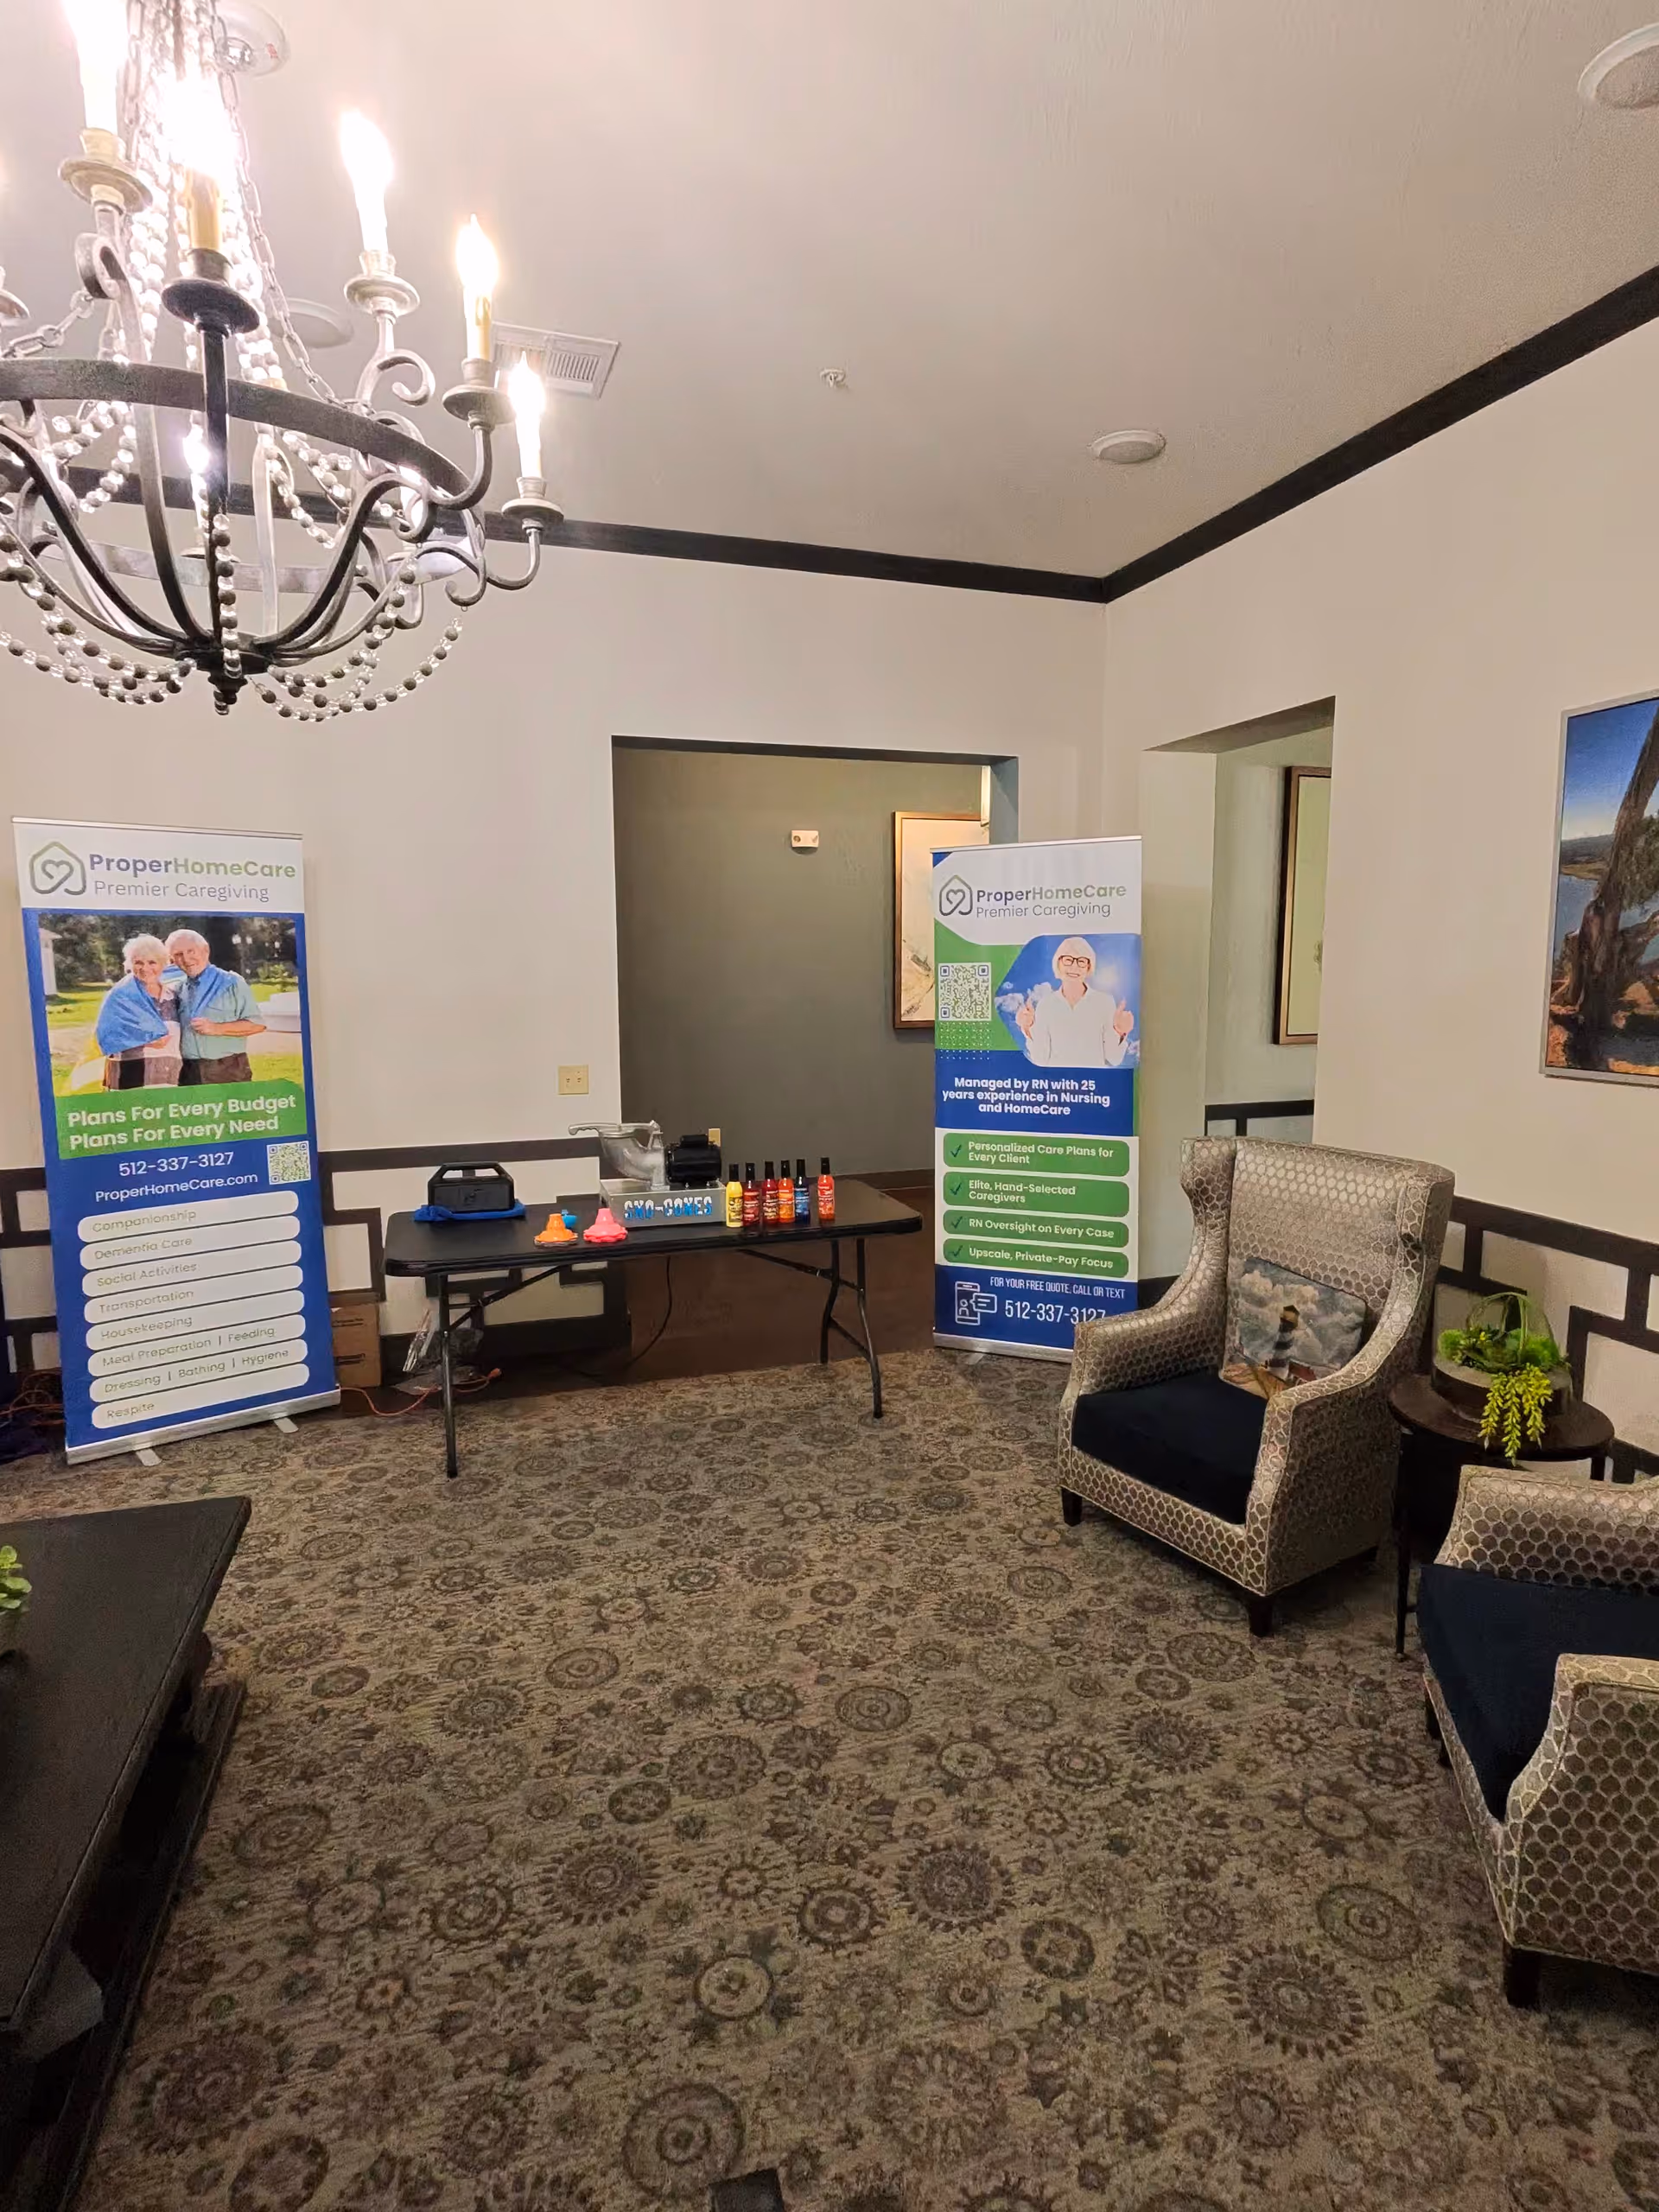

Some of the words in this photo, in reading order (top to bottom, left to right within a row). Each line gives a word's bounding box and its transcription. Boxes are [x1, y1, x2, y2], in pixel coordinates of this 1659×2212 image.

[89, 854, 296, 878] ProperHomeCare
[94, 880, 169, 898] Premier
[175, 882, 270, 902] Caregiving
[976, 884, 1127, 906] ProperHomeCare
[976, 906, 1028, 918] Premier
[1033, 902, 1111, 918] Caregiving
[954, 1077, 1012, 1090] Managed
[1014, 1079, 1029, 1092] by
[1032, 1079, 1049, 1090] RN
[1051, 1079, 1078, 1090] with
[1081, 1080, 1096, 1090] 25
[942, 1090, 975, 1102] years
[976, 1091, 1044, 1103] experience
[1046, 1091, 1058, 1103] in
[1061, 1092, 1110, 1107] Nursing
[978, 1103, 1002, 1113] and
[1004, 1103, 1071, 1116] HomeCare
[67, 1109, 126, 1128] Plans
[131, 1106, 164, 1122] For
[168, 1103, 223, 1118] Every
[227, 1095, 296, 1114] Budget
[69, 1132, 128, 1150] Plans
[133, 1128, 165, 1142] For
[170, 1123, 225, 1140] Every
[229, 1116, 278, 1134] Need
[969, 1141, 1035, 1154] Personalized
[1037, 1145, 1064, 1154] Care
[1066, 1146, 1096, 1156] Plans
[1097, 1147, 1114, 1158] for
[969, 1152, 996, 1164] Every
[999, 1153, 1030, 1164] Client
[119, 1152, 234, 1176] 512-337-3127
[95, 1174, 258, 1202] ProperHomeCare.com
[969, 1179, 993, 1192] Elite,
[995, 1181, 1076, 1195] Hand-Selected
[969, 1192, 1026, 1204] Caregivers
[624, 1196, 712, 1220] SNO-CONES
[92, 1210, 197, 1233] Companionship
[969, 1218, 982, 1229] RN
[985, 1220, 1037, 1234] Oversight
[1038, 1224, 1052, 1233] on
[1054, 1224, 1084, 1237] Every
[1086, 1227, 1114, 1238] Case
[94, 1242, 158, 1260] Dementia
[162, 1238, 192, 1249] Care
[969, 1248, 1014, 1261] Upscale,
[1015, 1251, 1079, 1268] Private-Pay
[1081, 1256, 1114, 1268] Focus
[97, 1272, 136, 1287] Social
[140, 1263, 197, 1280] Activities
[990, 1276, 1004, 1287] FOR
[1005, 1278, 1025, 1289] YOUR
[1026, 1280, 1044, 1291] FREE
[1073, 1284, 1092, 1296] CALL
[1093, 1286, 1104, 1297] OR
[1105, 1287, 1125, 1299] TEXT
[99, 1290, 194, 1314] Transportation
[101, 1316, 193, 1340] Housekeeping
[102, 1353, 134, 1367] Meal
[138, 1338, 212, 1361] Preparation
[228, 1327, 275, 1343] Feeding
[105, 1374, 161, 1394] Dressing
[178, 1362, 226, 1378] Bathing
[242, 1349, 289, 1366] Hygiene
[106, 1402, 155, 1420] Respite
